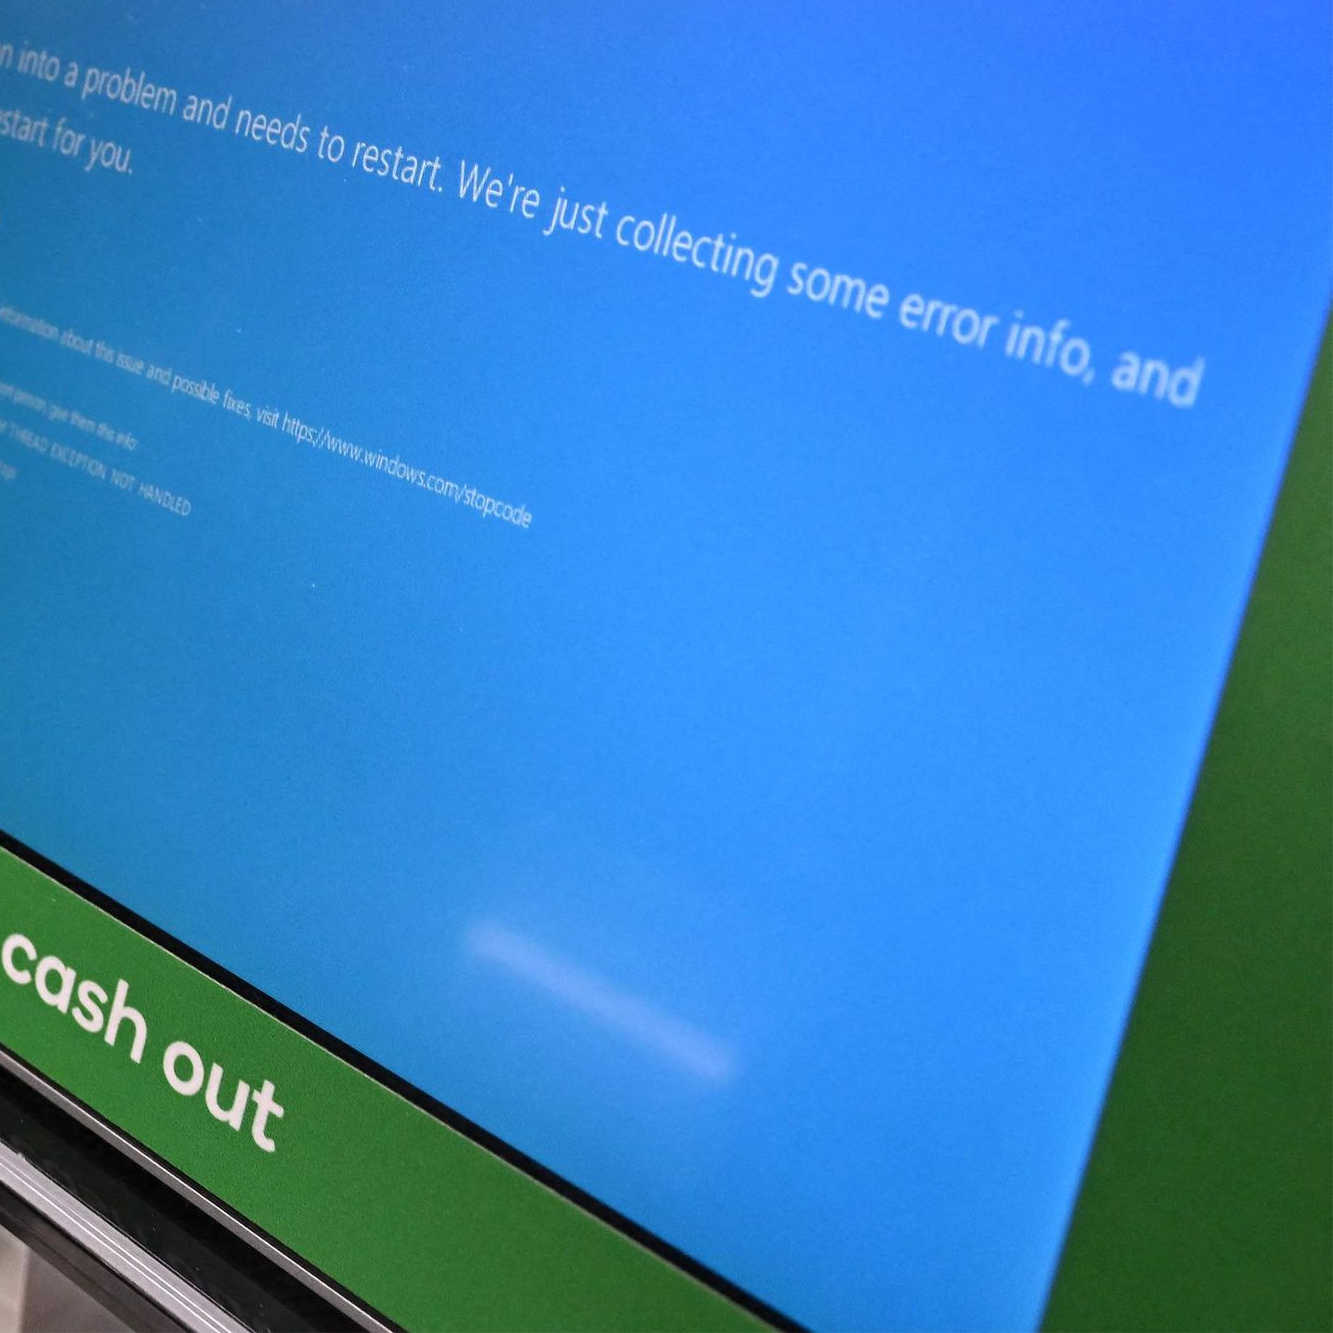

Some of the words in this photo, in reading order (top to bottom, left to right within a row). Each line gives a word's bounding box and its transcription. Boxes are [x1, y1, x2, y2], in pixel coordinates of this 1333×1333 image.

[17, 40, 61, 82] into
[64, 61, 79, 88] a
[81, 67, 178, 116] problem
[183, 94, 233, 131] and
[235, 107, 311, 154] needs
[316, 125, 345, 163] to
[351, 140, 443, 194] restart.
[459, 159, 540, 219] We're
[542, 185, 609, 239] just
[615, 213, 780, 299] collecting
[786, 262, 891, 319] some
[898, 292, 1000, 349] error
[1004, 309, 1096, 387] info,
[1110, 350, 1207, 409] and
[52, 117, 86, 157] for
[85, 138, 134, 175] you.
[59, 327, 94, 355] about
[93, 339, 115, 364] this
[116, 351, 145, 376] issue
[145, 363, 173, 387] and
[171, 375, 220, 406] possible
[222, 388, 252, 421] fixes,
[255, 404, 280, 430] visit
[280, 411, 533, 529] https://www.windows.com/stopcode
[0, 932, 149, 1065] cash
[161, 1040, 286, 1154] out
